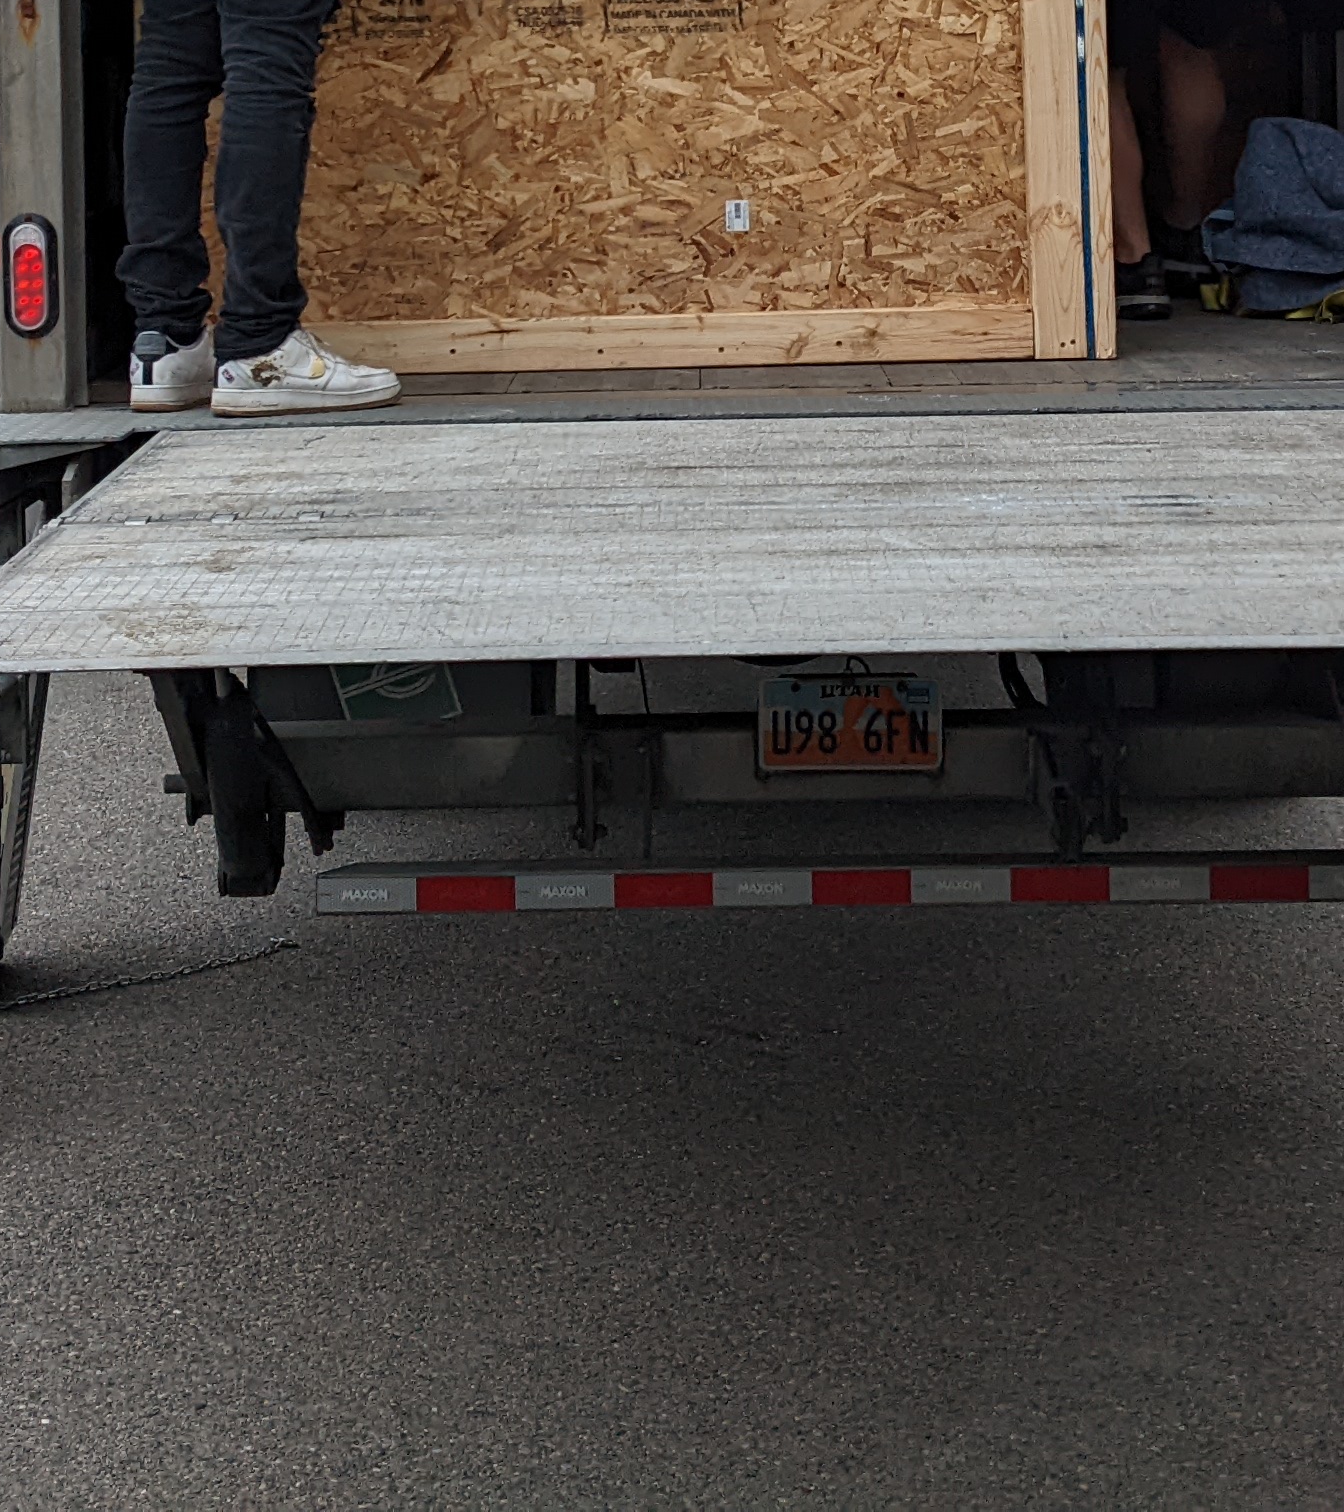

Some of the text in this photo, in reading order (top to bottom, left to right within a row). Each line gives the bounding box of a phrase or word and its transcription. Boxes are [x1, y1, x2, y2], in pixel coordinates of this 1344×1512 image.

[659, 8, 705, 19] CANADA
[820, 684, 881, 699] UTAH
[771, 708, 929, 755] U98 6FN
[539, 885, 587, 899] MAXON
[737, 881, 784, 896] MAXON
[935, 879, 982, 892] MAXON
[340, 888, 389, 903] MAXON
